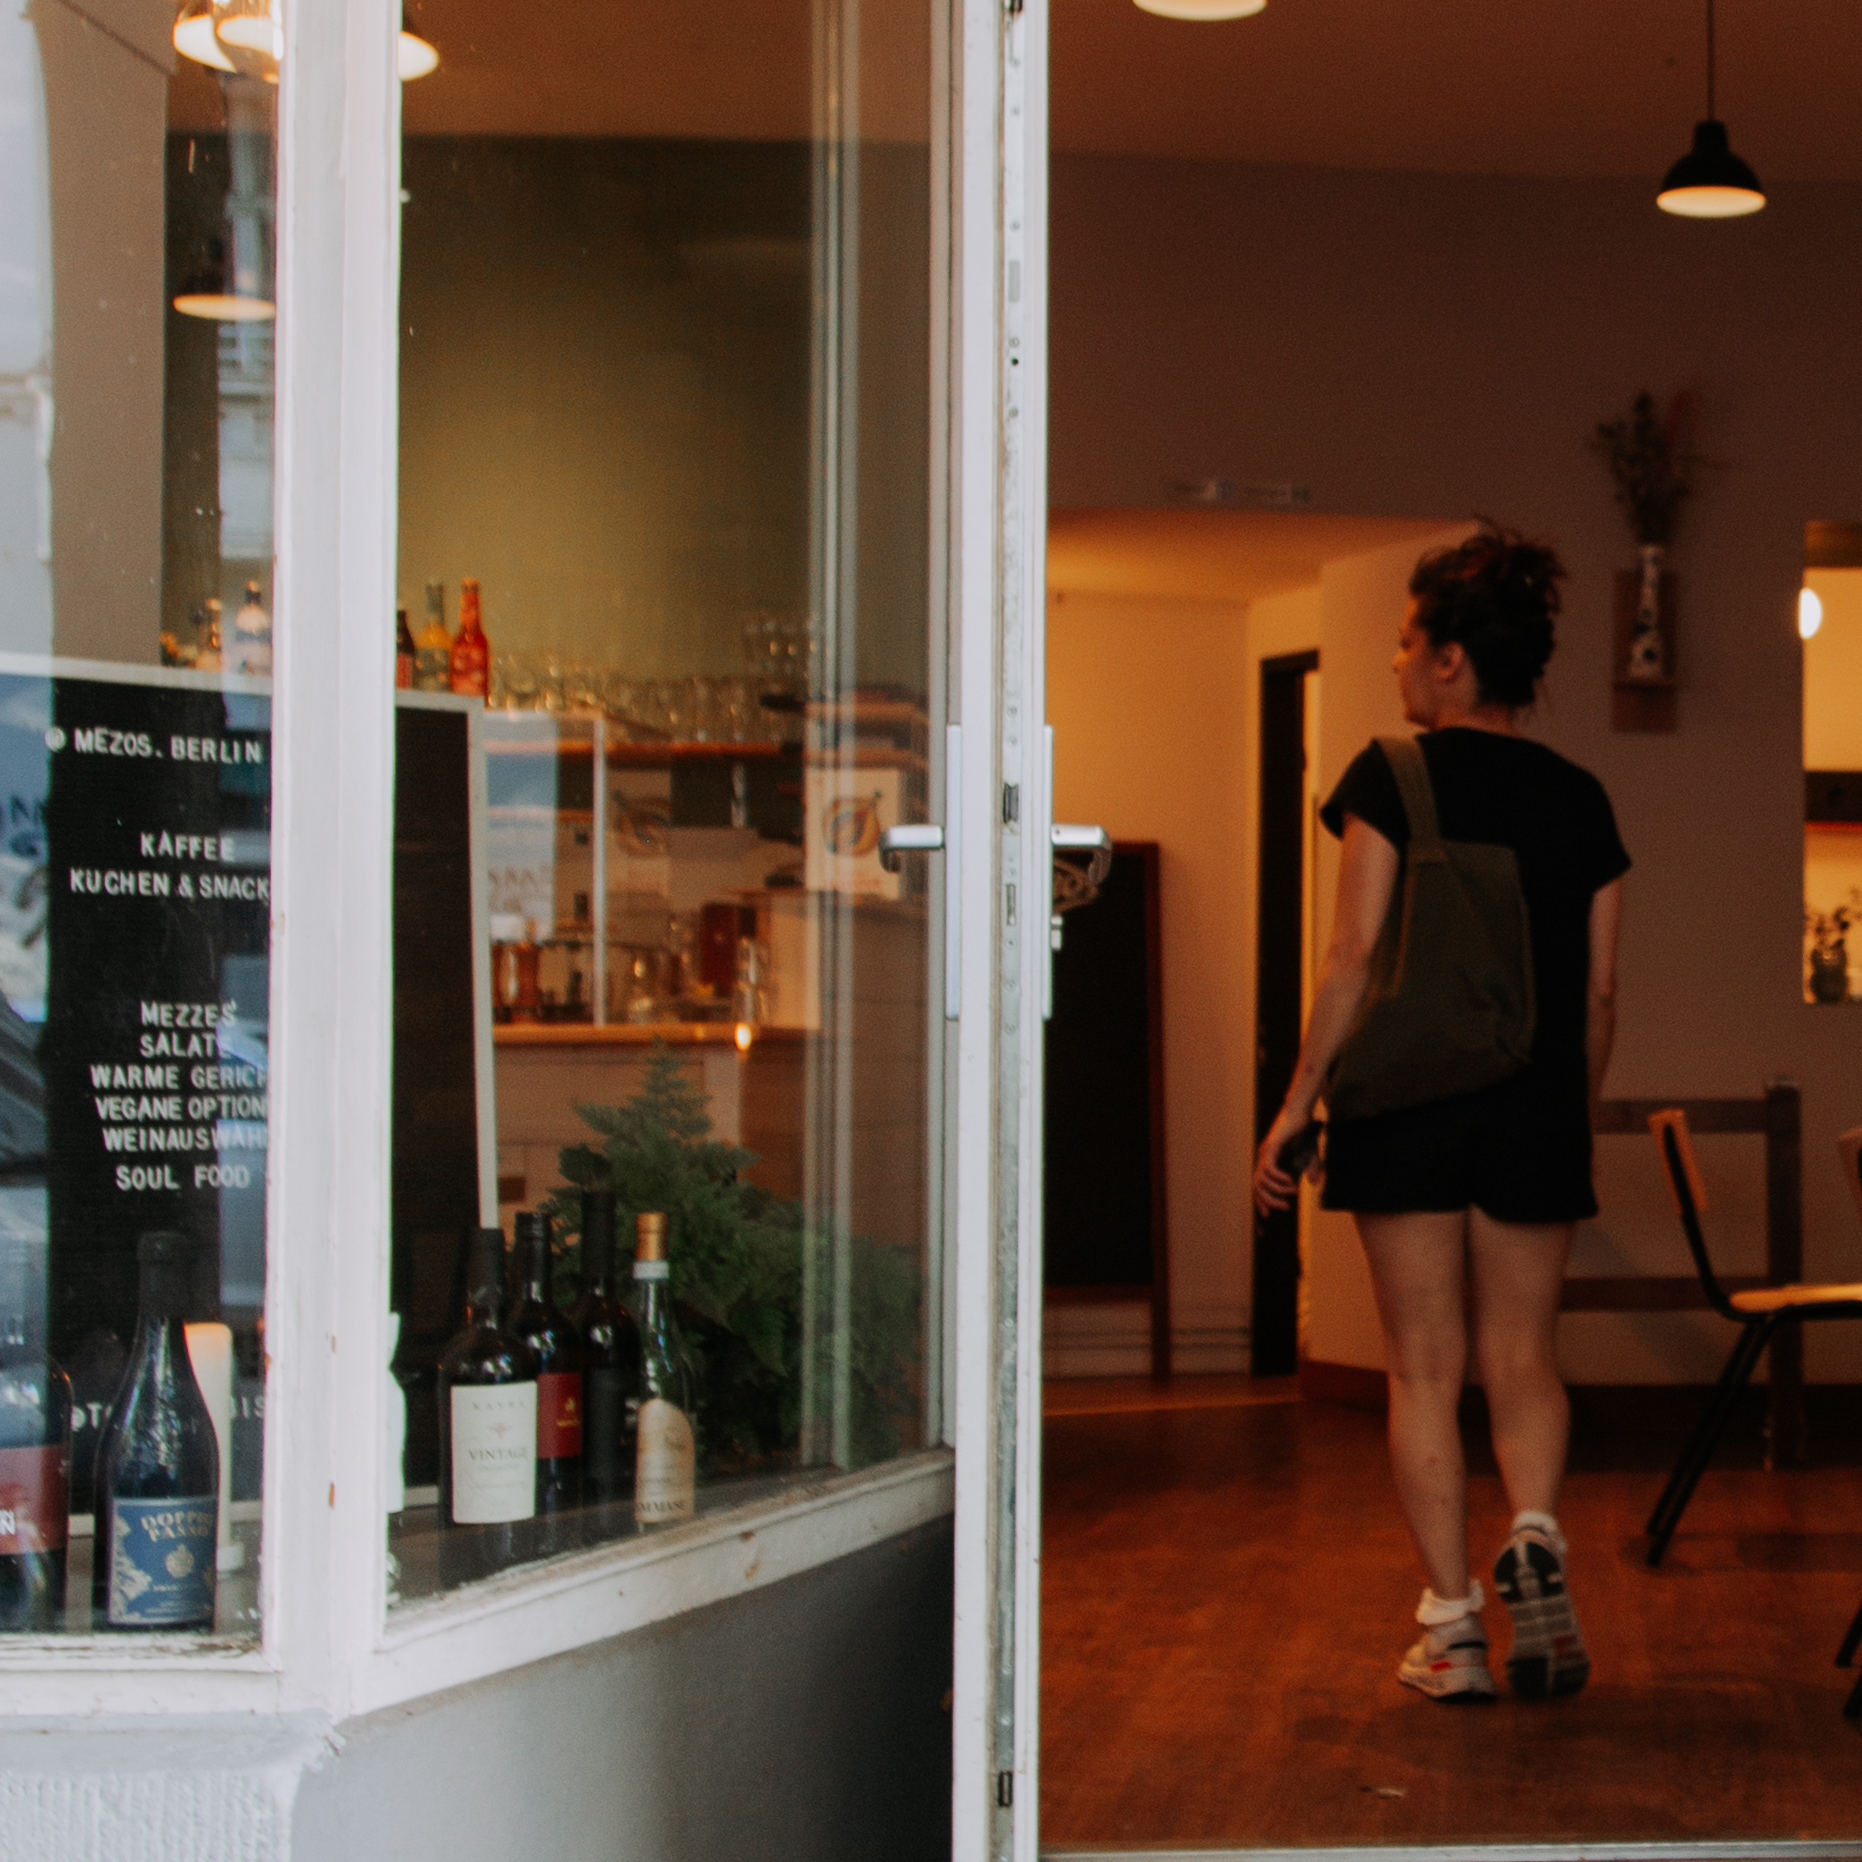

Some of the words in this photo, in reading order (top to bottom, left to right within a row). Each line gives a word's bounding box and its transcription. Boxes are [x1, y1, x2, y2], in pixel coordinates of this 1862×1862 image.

[169, 736, 263, 763] BERLIN
[139, 829, 235, 862] KAFFEE
[69, 866, 170, 897] KUCHEN
[177, 871, 194, 898] &
[139, 1031, 231, 1059] SALAT
[90, 1064, 181, 1089] WARME
[95, 1095, 182, 1121] VEGANE
[102, 1125, 268, 1152] WEINAUSWAH
[115, 1164, 180, 1191] SOUL
[194, 1164, 251, 1189] FOOD
